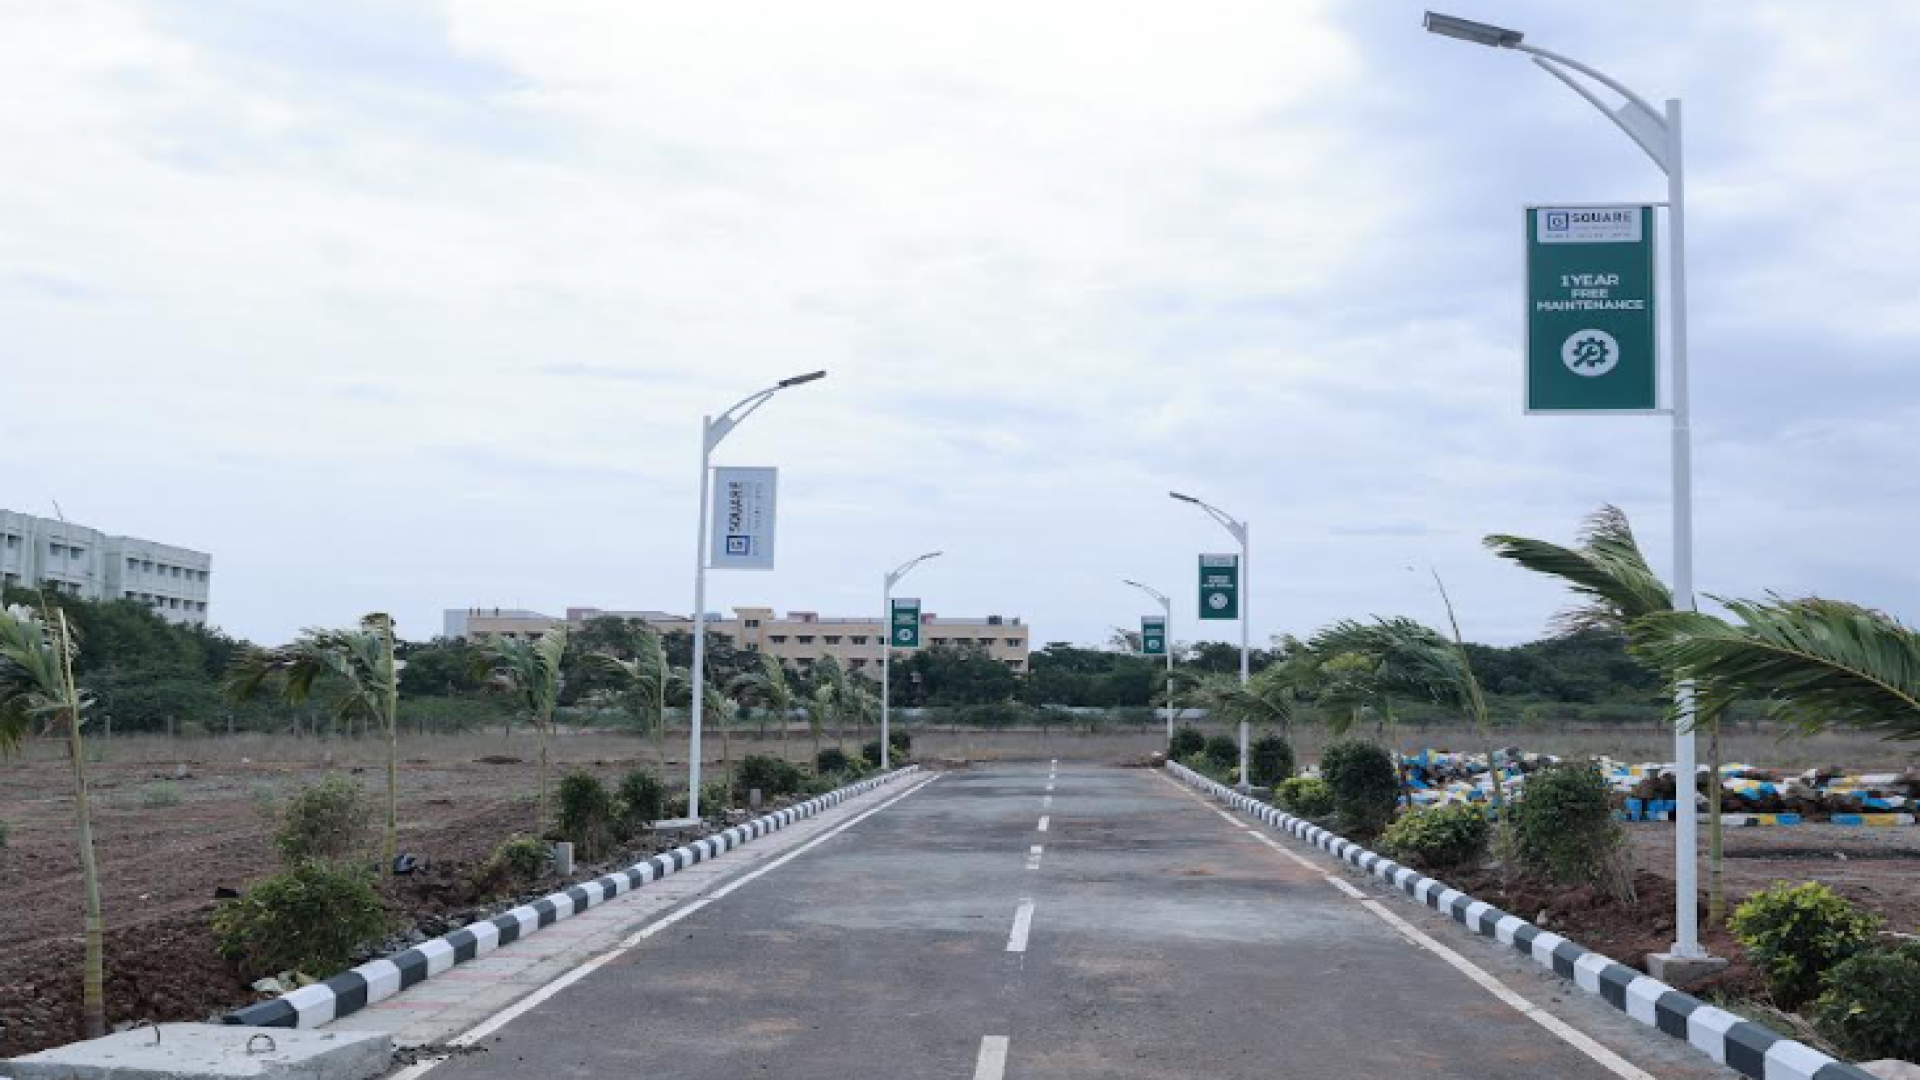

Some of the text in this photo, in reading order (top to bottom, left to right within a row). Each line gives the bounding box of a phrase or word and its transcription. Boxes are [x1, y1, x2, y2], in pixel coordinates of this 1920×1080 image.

[1571, 212, 1632, 223] SQUARE
[1571, 274, 1619, 286] YEAR
[1571, 288, 1609, 299] FREE
[1537, 300, 1645, 311] MAINTENANCE
[728, 482, 742, 533] SQUARE
